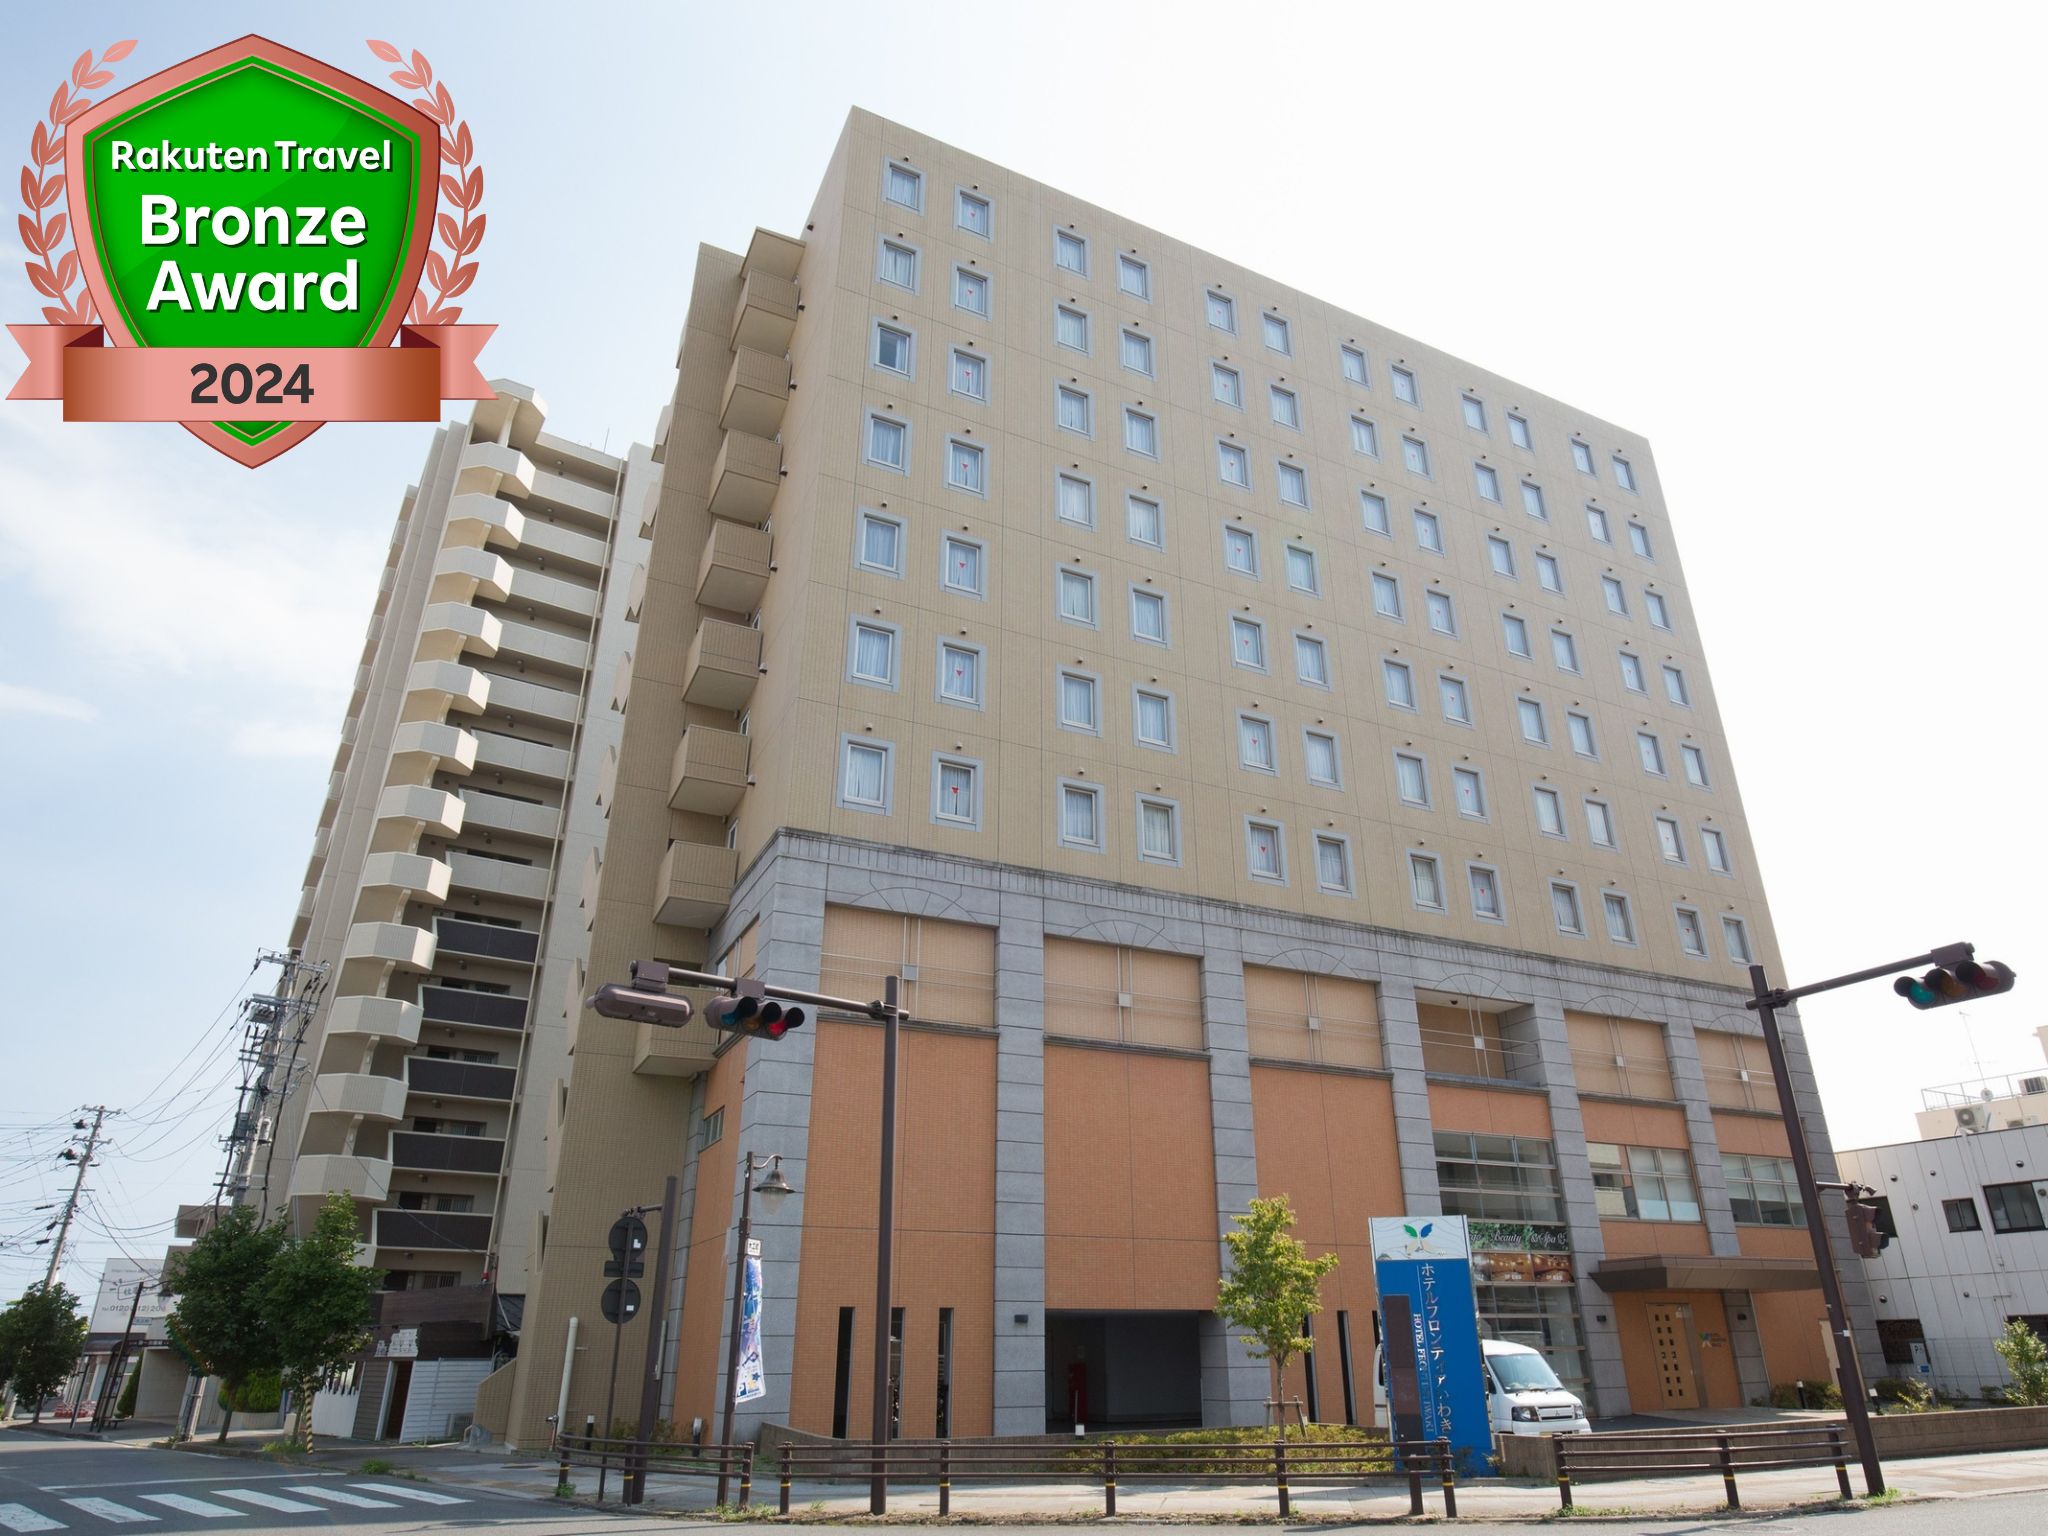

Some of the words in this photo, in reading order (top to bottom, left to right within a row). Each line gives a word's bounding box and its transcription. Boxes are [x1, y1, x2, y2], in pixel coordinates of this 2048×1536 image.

[1491, 1230, 1522, 1245] Beauty
[1413, 1314, 1425, 1347] HOTEL
[1423, 1401, 1434, 1432] IWAKI
